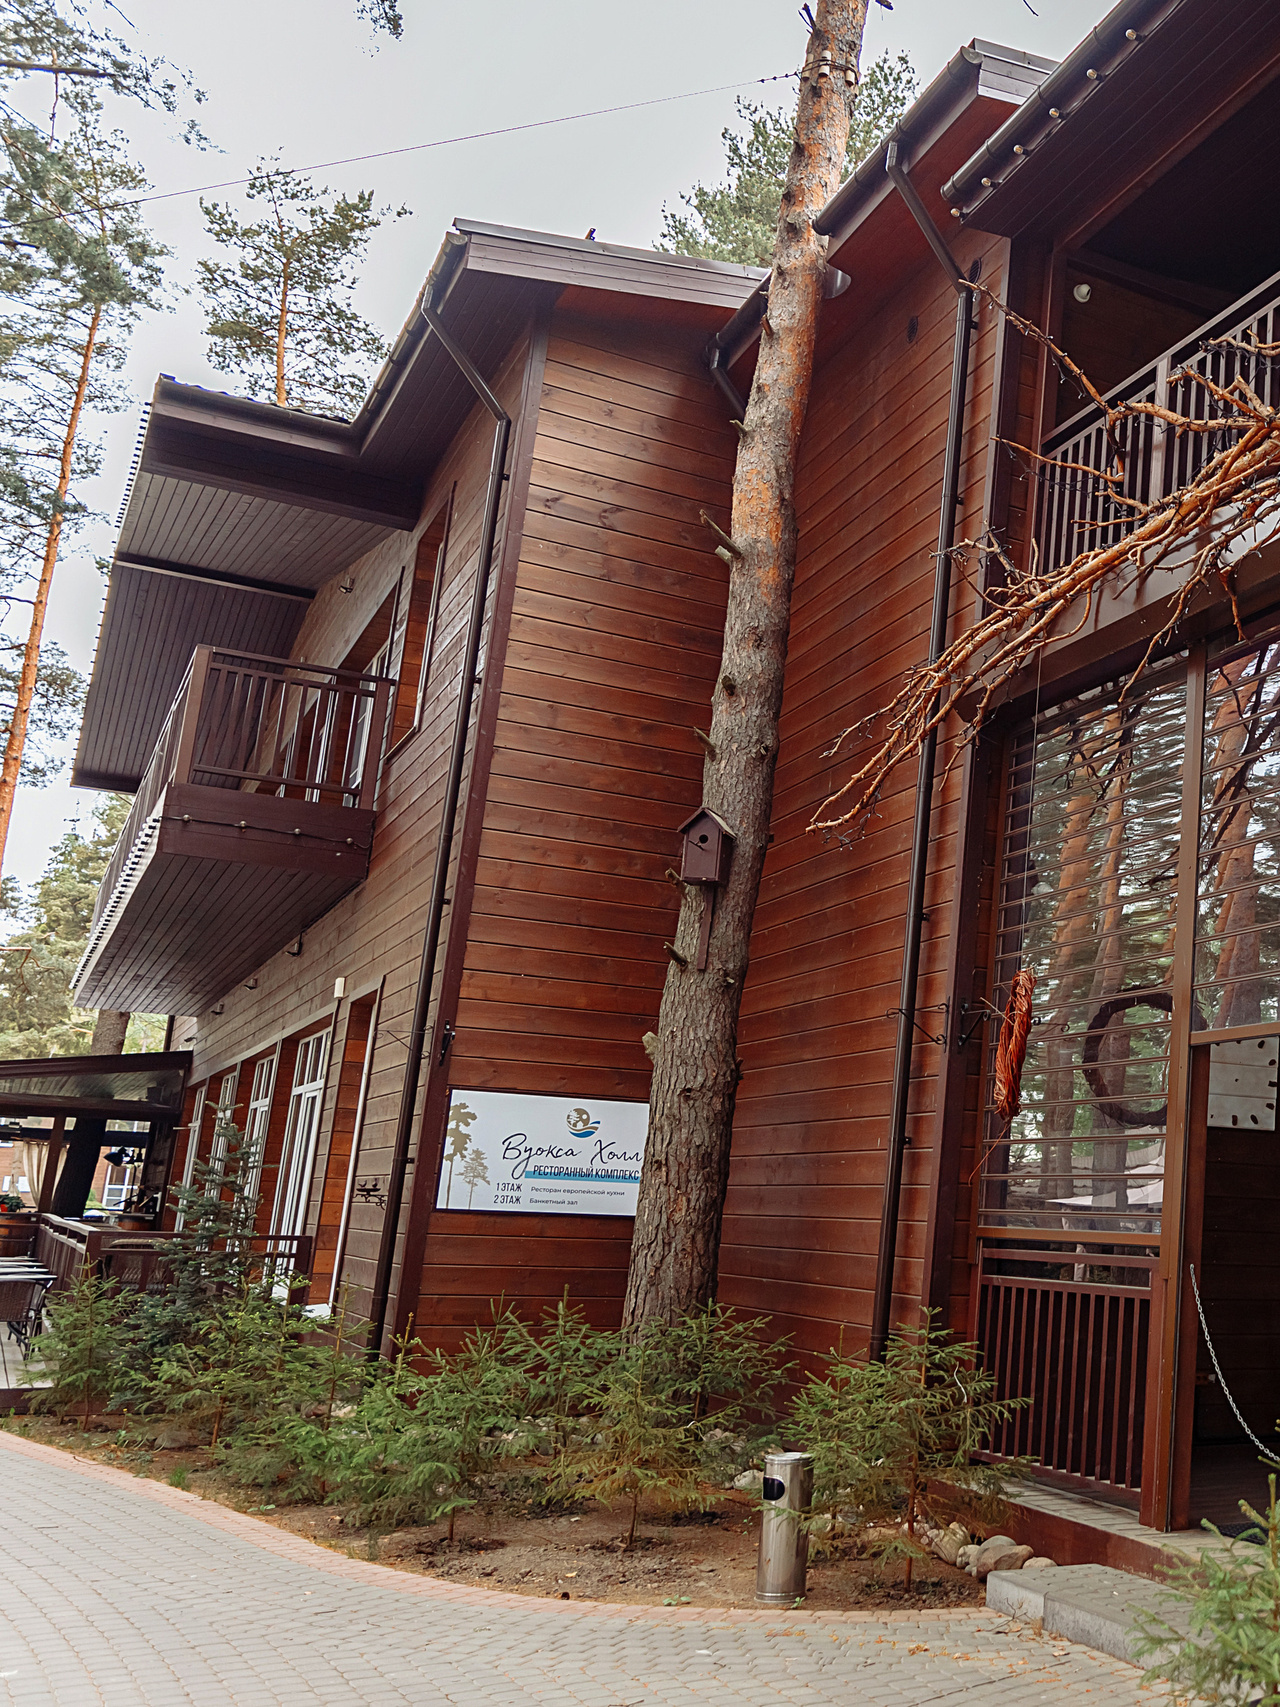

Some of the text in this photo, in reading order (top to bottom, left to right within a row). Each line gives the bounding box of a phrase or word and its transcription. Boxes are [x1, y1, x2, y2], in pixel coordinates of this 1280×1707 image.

[502, 1133, 643, 1180] Вуокса Холл
[533, 1165, 640, 1180] РЕСТОРАННЫЙ КОМПЛЕКС
[501, 1183, 523, 1192] ЭТАЖ
[531, 1186, 562, 1194] Ресторан
[562, 1188, 606, 1196] европейской
[493, 1195, 522, 1205] 2 ЭТАЖ
